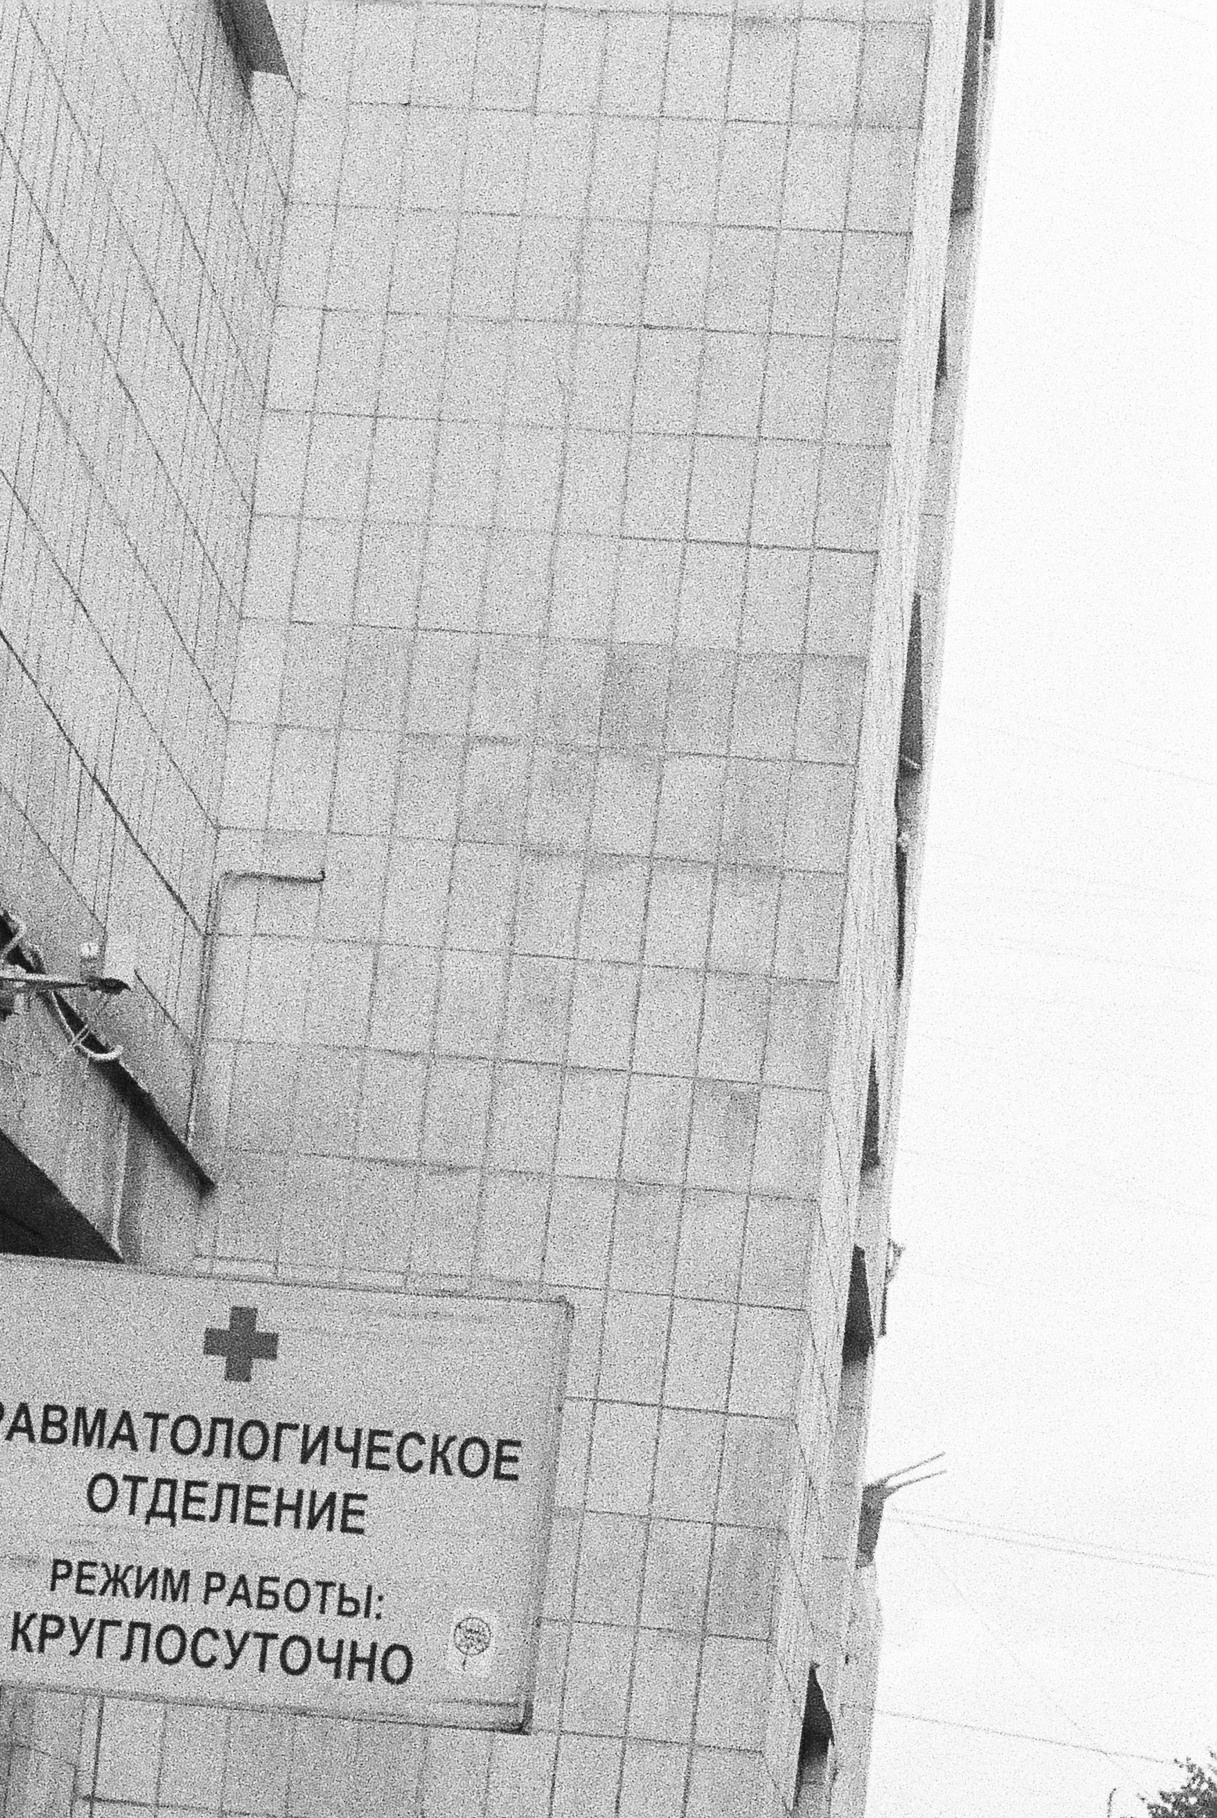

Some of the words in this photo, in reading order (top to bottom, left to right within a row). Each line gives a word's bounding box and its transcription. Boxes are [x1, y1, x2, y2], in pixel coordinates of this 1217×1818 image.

[85, 1472, 368, 1535] ОТДЕЛЕНИЕ
[50, 1558, 191, 1602] РЕЖИМ
[203, 1571, 384, 1620] РАБОТЫ:
[9, 1611, 414, 1686] КРУГЛОСУТОЧНО
